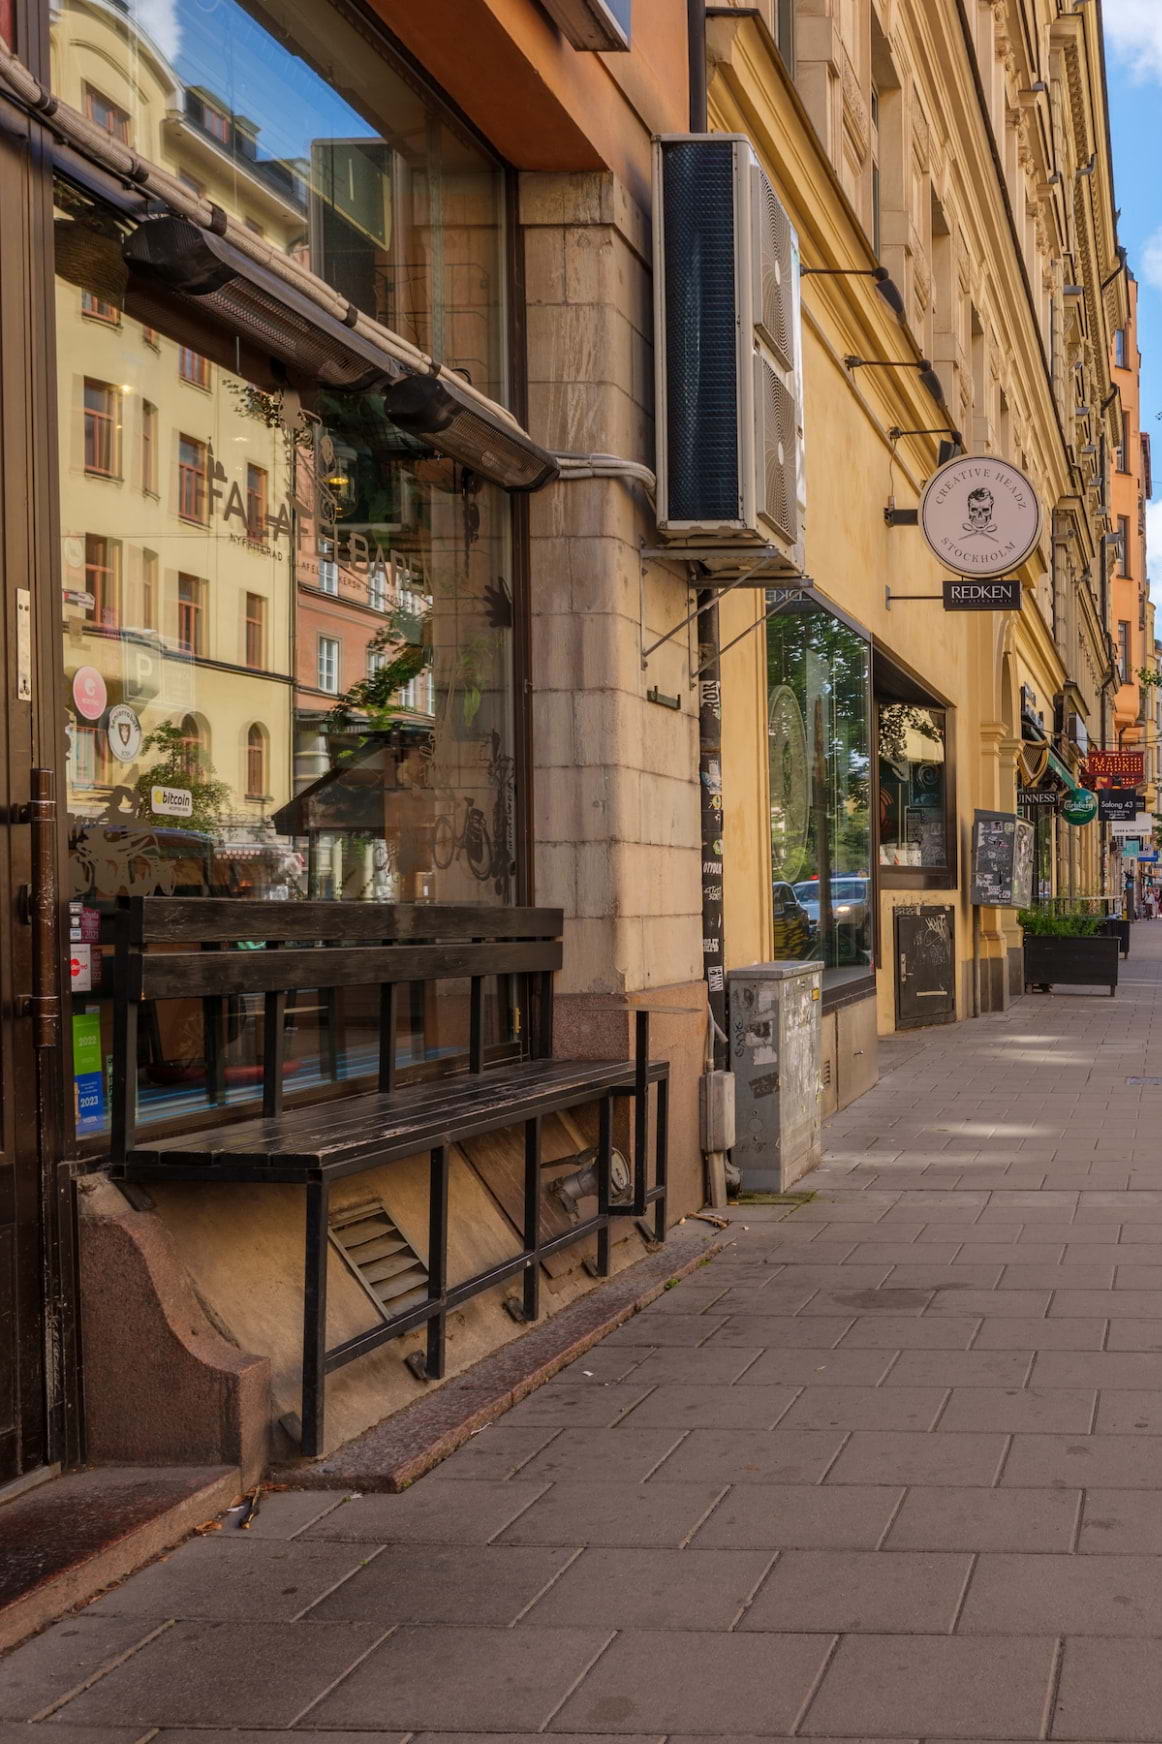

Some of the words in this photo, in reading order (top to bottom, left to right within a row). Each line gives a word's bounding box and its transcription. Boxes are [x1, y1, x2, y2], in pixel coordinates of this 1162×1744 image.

[935, 468, 991, 505] CREATIVE
[995, 472, 1027, 510] HEADZ
[941, 536, 1016, 563] STOCKHOLM
[951, 584, 1012, 599] REDKEN
[163, 791, 190, 807] bitcoin
[1017, 793, 1056, 803] UINNESS
[1063, 799, 1094, 811] Carlsberg
[1101, 801, 1123, 809] Salong
[80, 1096, 98, 1108] 2023
